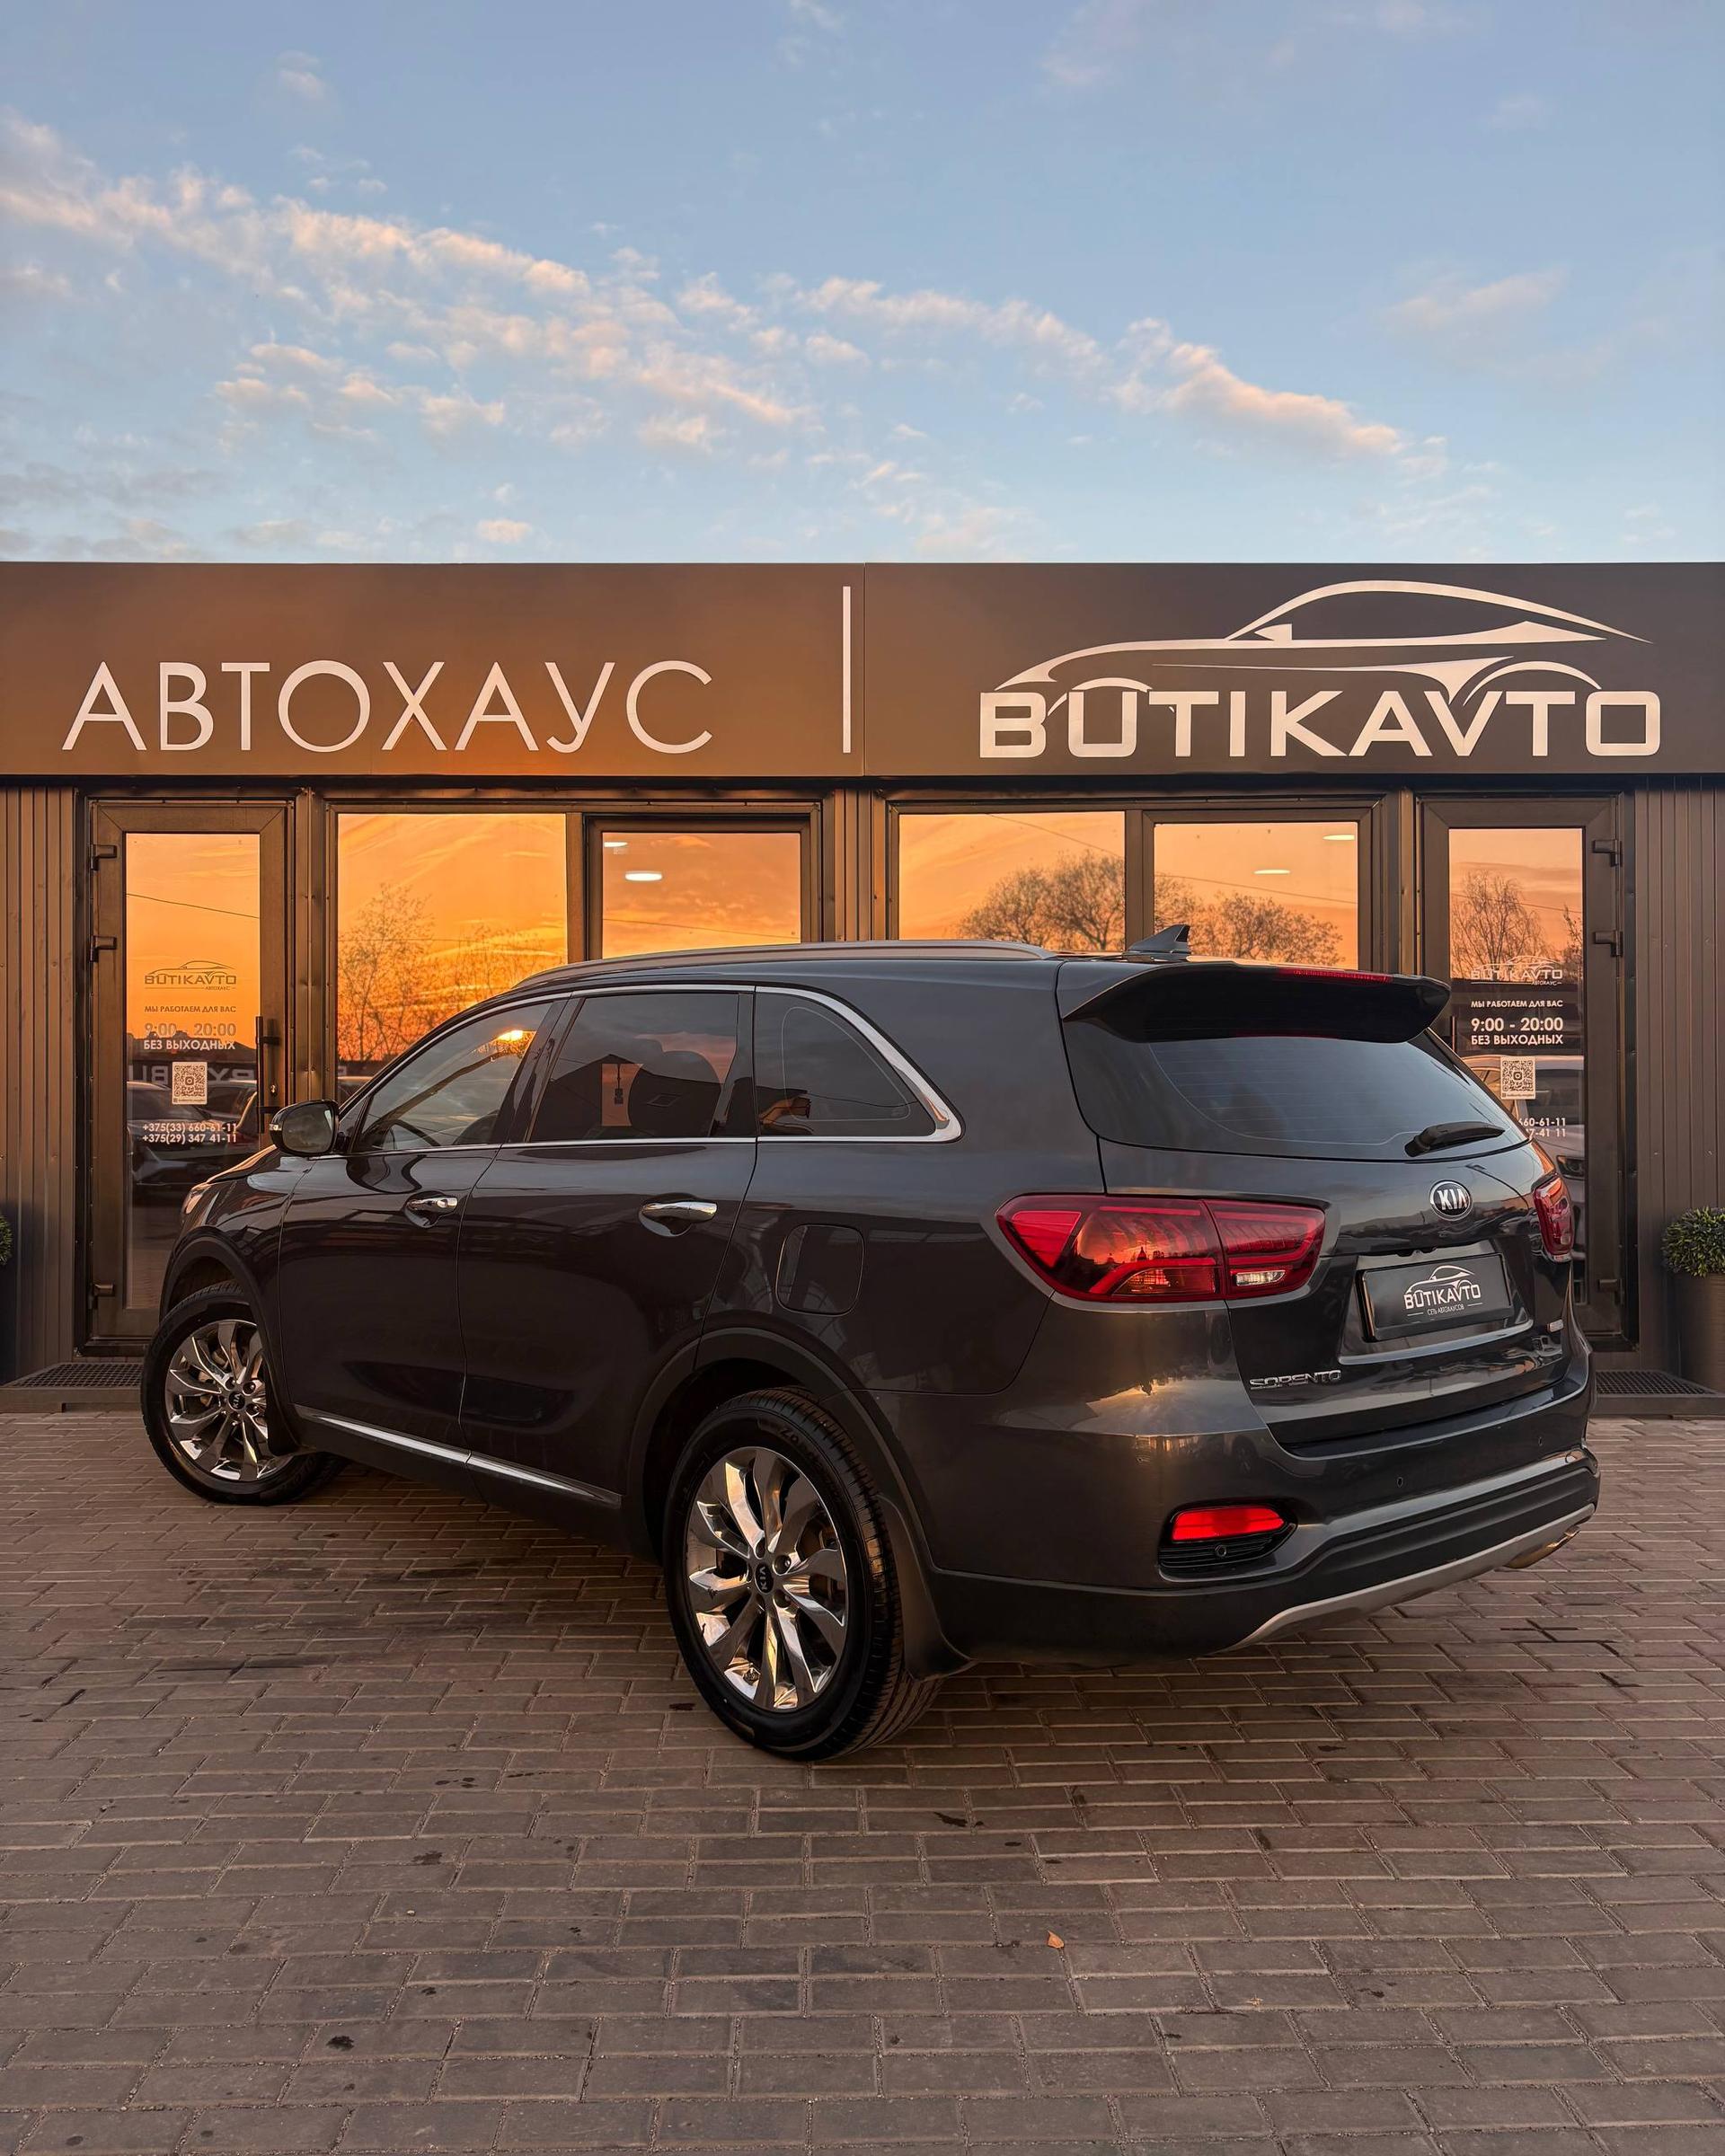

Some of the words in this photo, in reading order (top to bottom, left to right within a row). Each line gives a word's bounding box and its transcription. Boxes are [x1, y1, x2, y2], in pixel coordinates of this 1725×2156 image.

[62, 660, 712, 754] АВТОХАУС
[979, 690, 1661, 758] BUTIKAVTO
[145, 975, 237, 985] BUTIKAVTO
[1471, 968, 1562, 980] BUTIKAVTO
[202, 1005, 218, 1013] ДЛЯ
[1471, 1000, 1484, 1008] МЫ
[1486, 1000, 1527, 1008] РАБОТАЕМ
[1528, 1000, 1545, 1008] ДЛЯ
[1547, 1000, 1563, 1008] ВАС
[145, 1022, 177, 1037] 9:00
[194, 1022, 237, 1037] 20:00
[1471, 1017, 1504, 1032] 9:00
[1520, 1017, 1563, 1031] 20:00
[144, 1039, 163, 1050] БЕЗ
[166, 1039, 235, 1051] ВЫХОДНЫХ
[1471, 1034, 1491, 1046] БЕЗ
[1493, 1034, 1563, 1046] ВЫХОДНЫХ
[142, 1122, 186, 1134] +375(33)
[188, 1123, 237, 1132] 660-61-11
[142, 1133, 186, 1144] +375(29)
[1438, 1188, 1467, 1210] KIA
[1403, 1284, 1482, 1310] BUTIKAVTO
[1250, 1369, 1341, 1390] SORENTO
